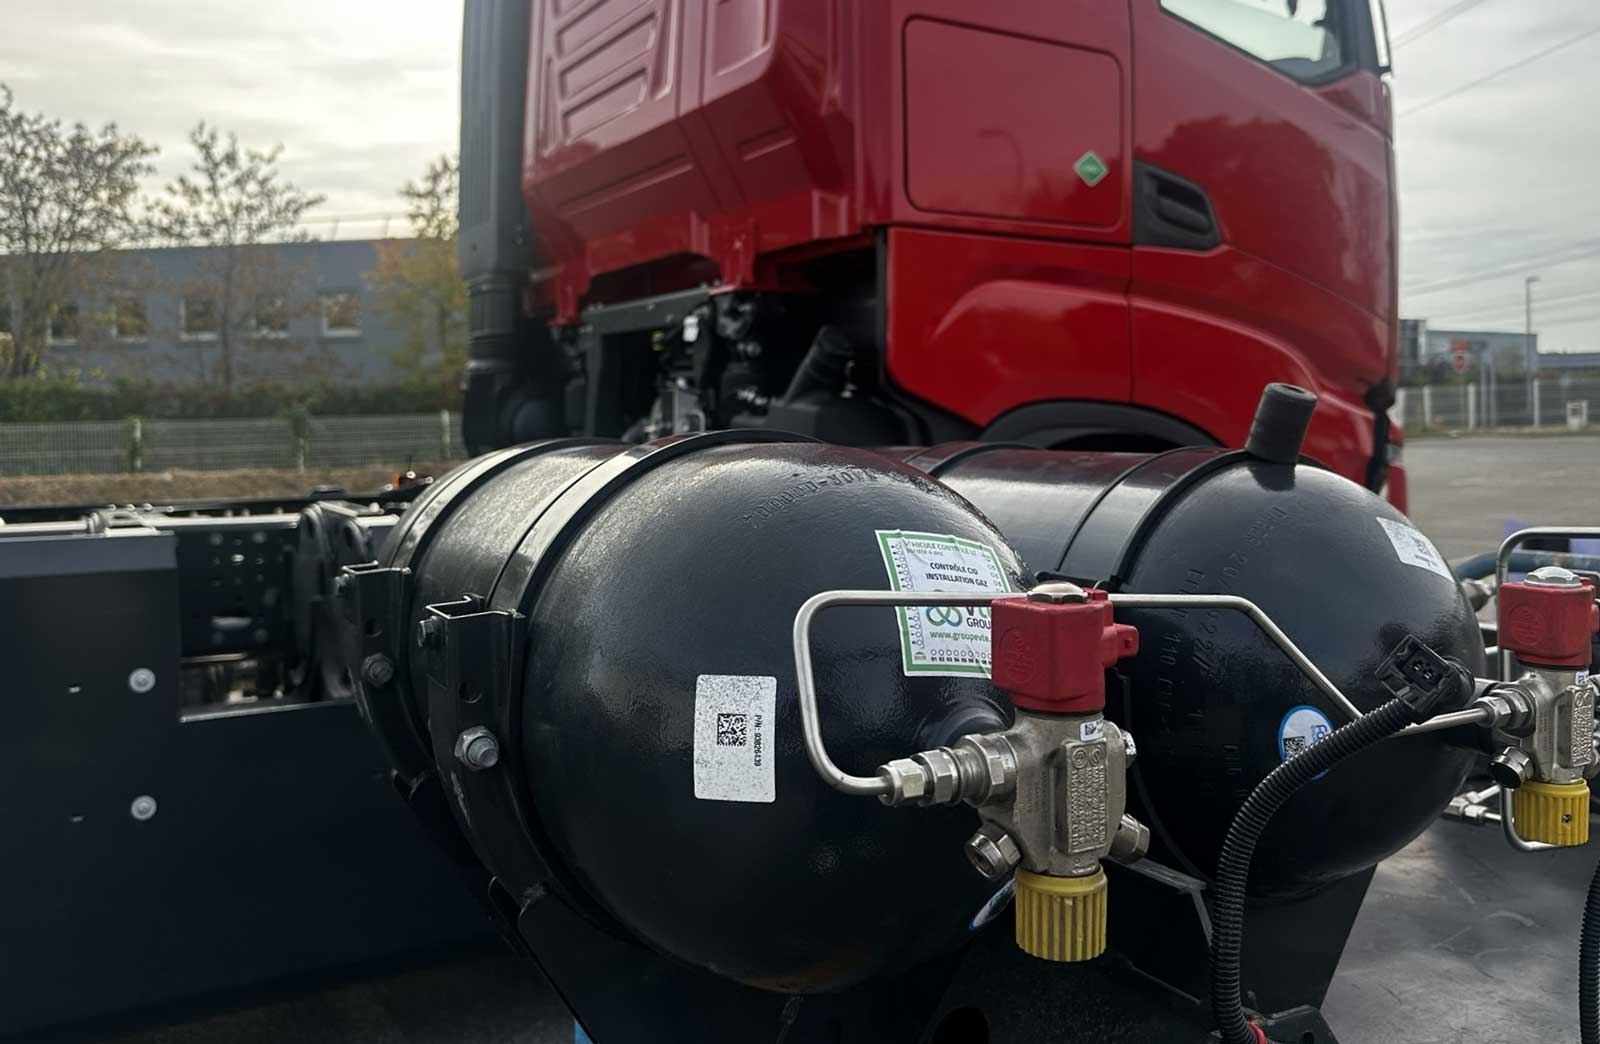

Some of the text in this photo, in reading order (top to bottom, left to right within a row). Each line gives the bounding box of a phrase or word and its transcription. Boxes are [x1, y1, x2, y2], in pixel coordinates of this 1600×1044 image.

[930, 562, 966, 573] CONTRÔLE
[926, 573, 975, 585] INSTALLATION
[975, 578, 988, 588] GAZ
[967, 617, 992, 629] GROU
